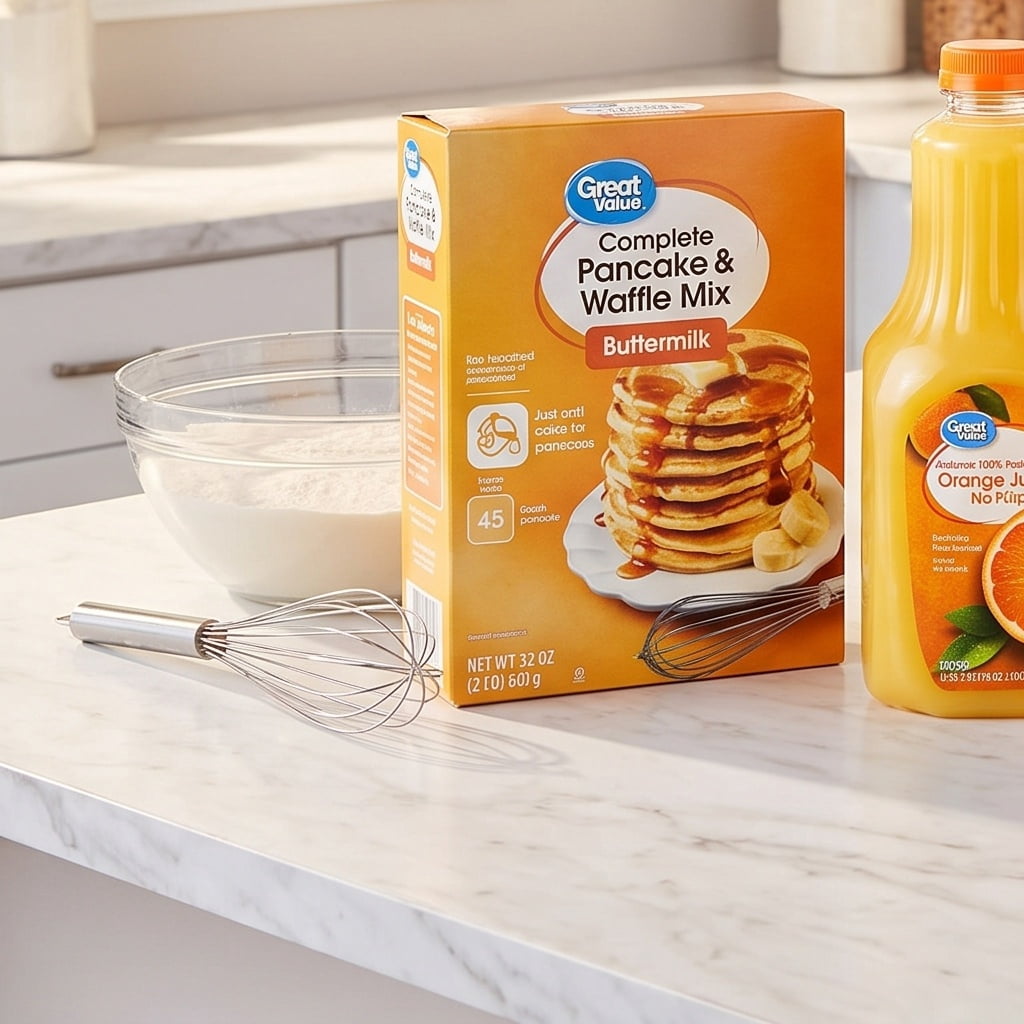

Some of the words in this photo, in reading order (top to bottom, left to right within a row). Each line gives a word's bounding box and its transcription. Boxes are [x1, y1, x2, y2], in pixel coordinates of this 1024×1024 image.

[577, 175, 642, 199] Great
[599, 226, 714, 254] Complete
[578, 251, 709, 284] Pancake
[714, 247, 735, 274] &
[580, 285, 672, 316] Waffle
[681, 281, 731, 309] Mix
[602, 328, 712, 357] Buttermilk
[534, 408, 558, 421] Just
[938, 472, 1005, 491] Orange
[971, 492, 993, 505] No
[477, 509, 504, 529] 45
[467, 656, 492, 673] NET
[495, 654, 517, 670] WT
[520, 652, 535, 668] 32
[538, 649, 555, 665] OZ
